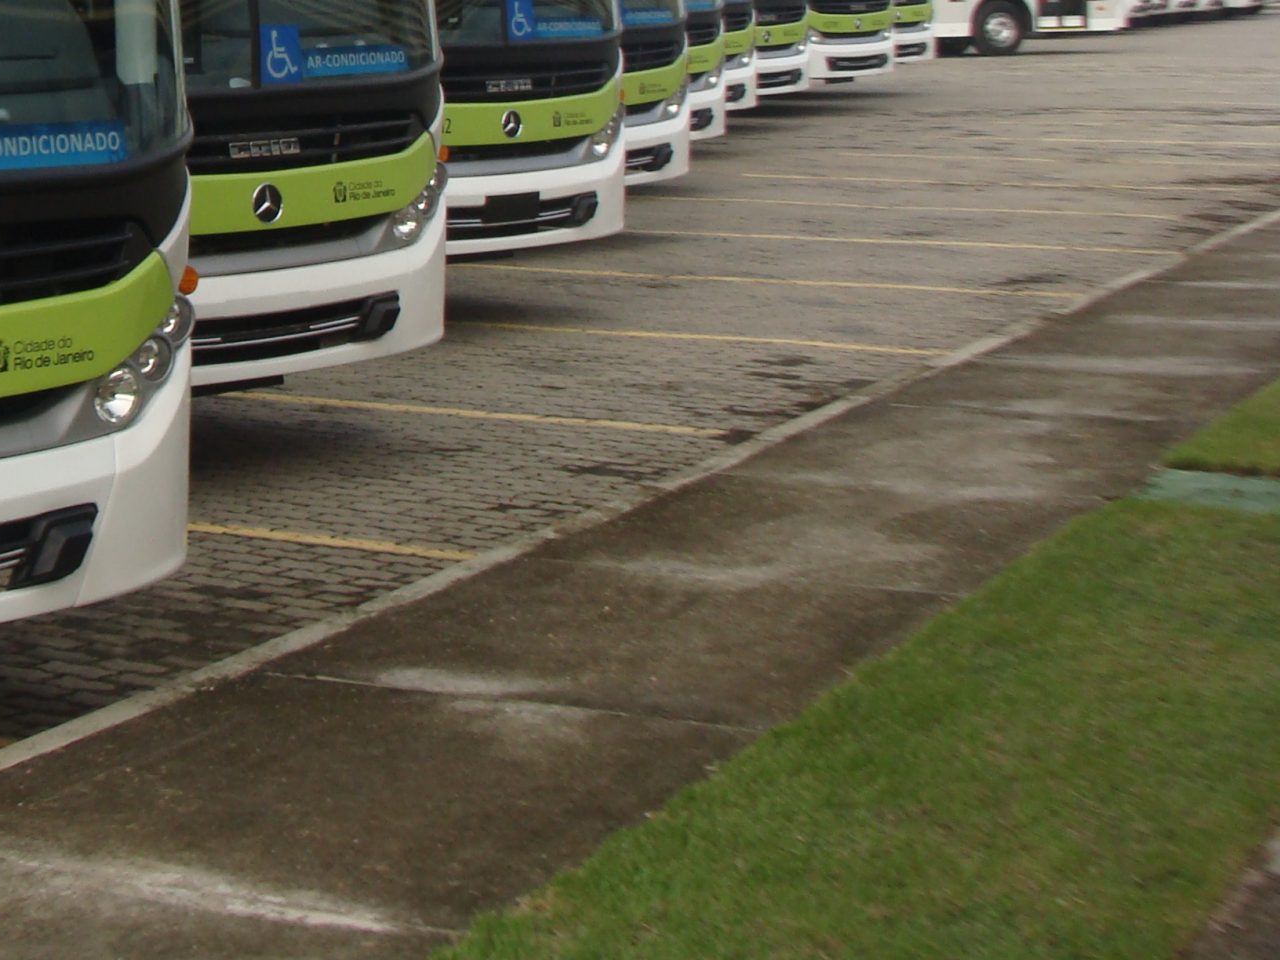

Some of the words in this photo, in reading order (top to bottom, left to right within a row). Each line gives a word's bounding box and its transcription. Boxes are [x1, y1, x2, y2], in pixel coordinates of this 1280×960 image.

[307, 51, 405, 69] AR-CONDICIONADO
[13, 339, 55, 355] Cidade
[57, 336, 72, 349] do
[13, 355, 33, 371] Rio
[34, 355, 51, 368] de
[53, 348, 94, 366] Janeiro
